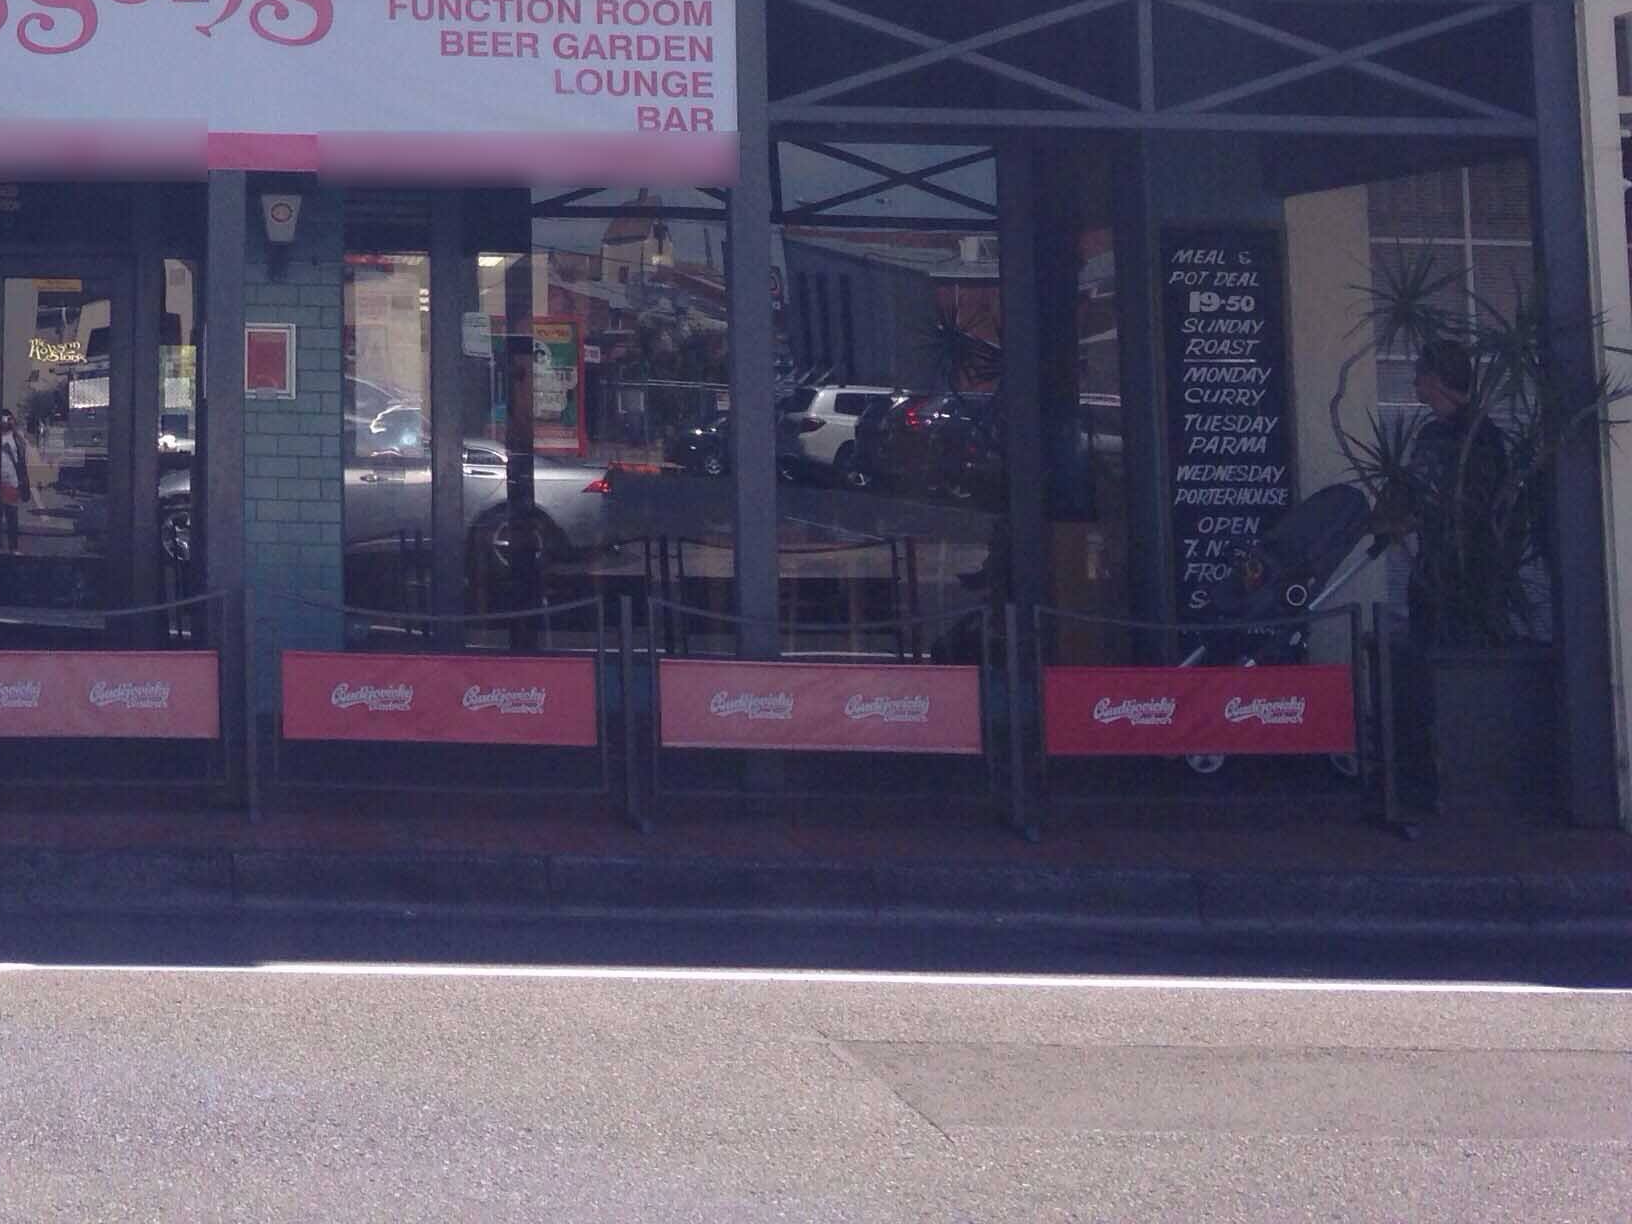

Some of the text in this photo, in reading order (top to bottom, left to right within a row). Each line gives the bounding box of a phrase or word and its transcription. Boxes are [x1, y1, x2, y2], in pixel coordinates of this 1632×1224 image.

[440, 30, 714, 63] BEER GARDEN
[554, 69, 715, 99] LOUNGE
[637, 106, 715, 133] BAR
[1170, 249, 1226, 265] MEAL
[1168, 271, 1260, 287] POT DEAL
[1181, 318, 1265, 335] SUNDAY
[1185, 338, 1262, 355] ROAST
[1183, 367, 1272, 385] MONDAY
[1184, 387, 1267, 406] CURRY
[1183, 413, 1279, 434] TUESDAY
[1188, 436, 1267, 455] PARMA
[1176, 465, 1285, 483] WEDNESDAY
[1174, 488, 1289, 505] PORTERHOUSE
[1197, 516, 1261, 534] OPEN
